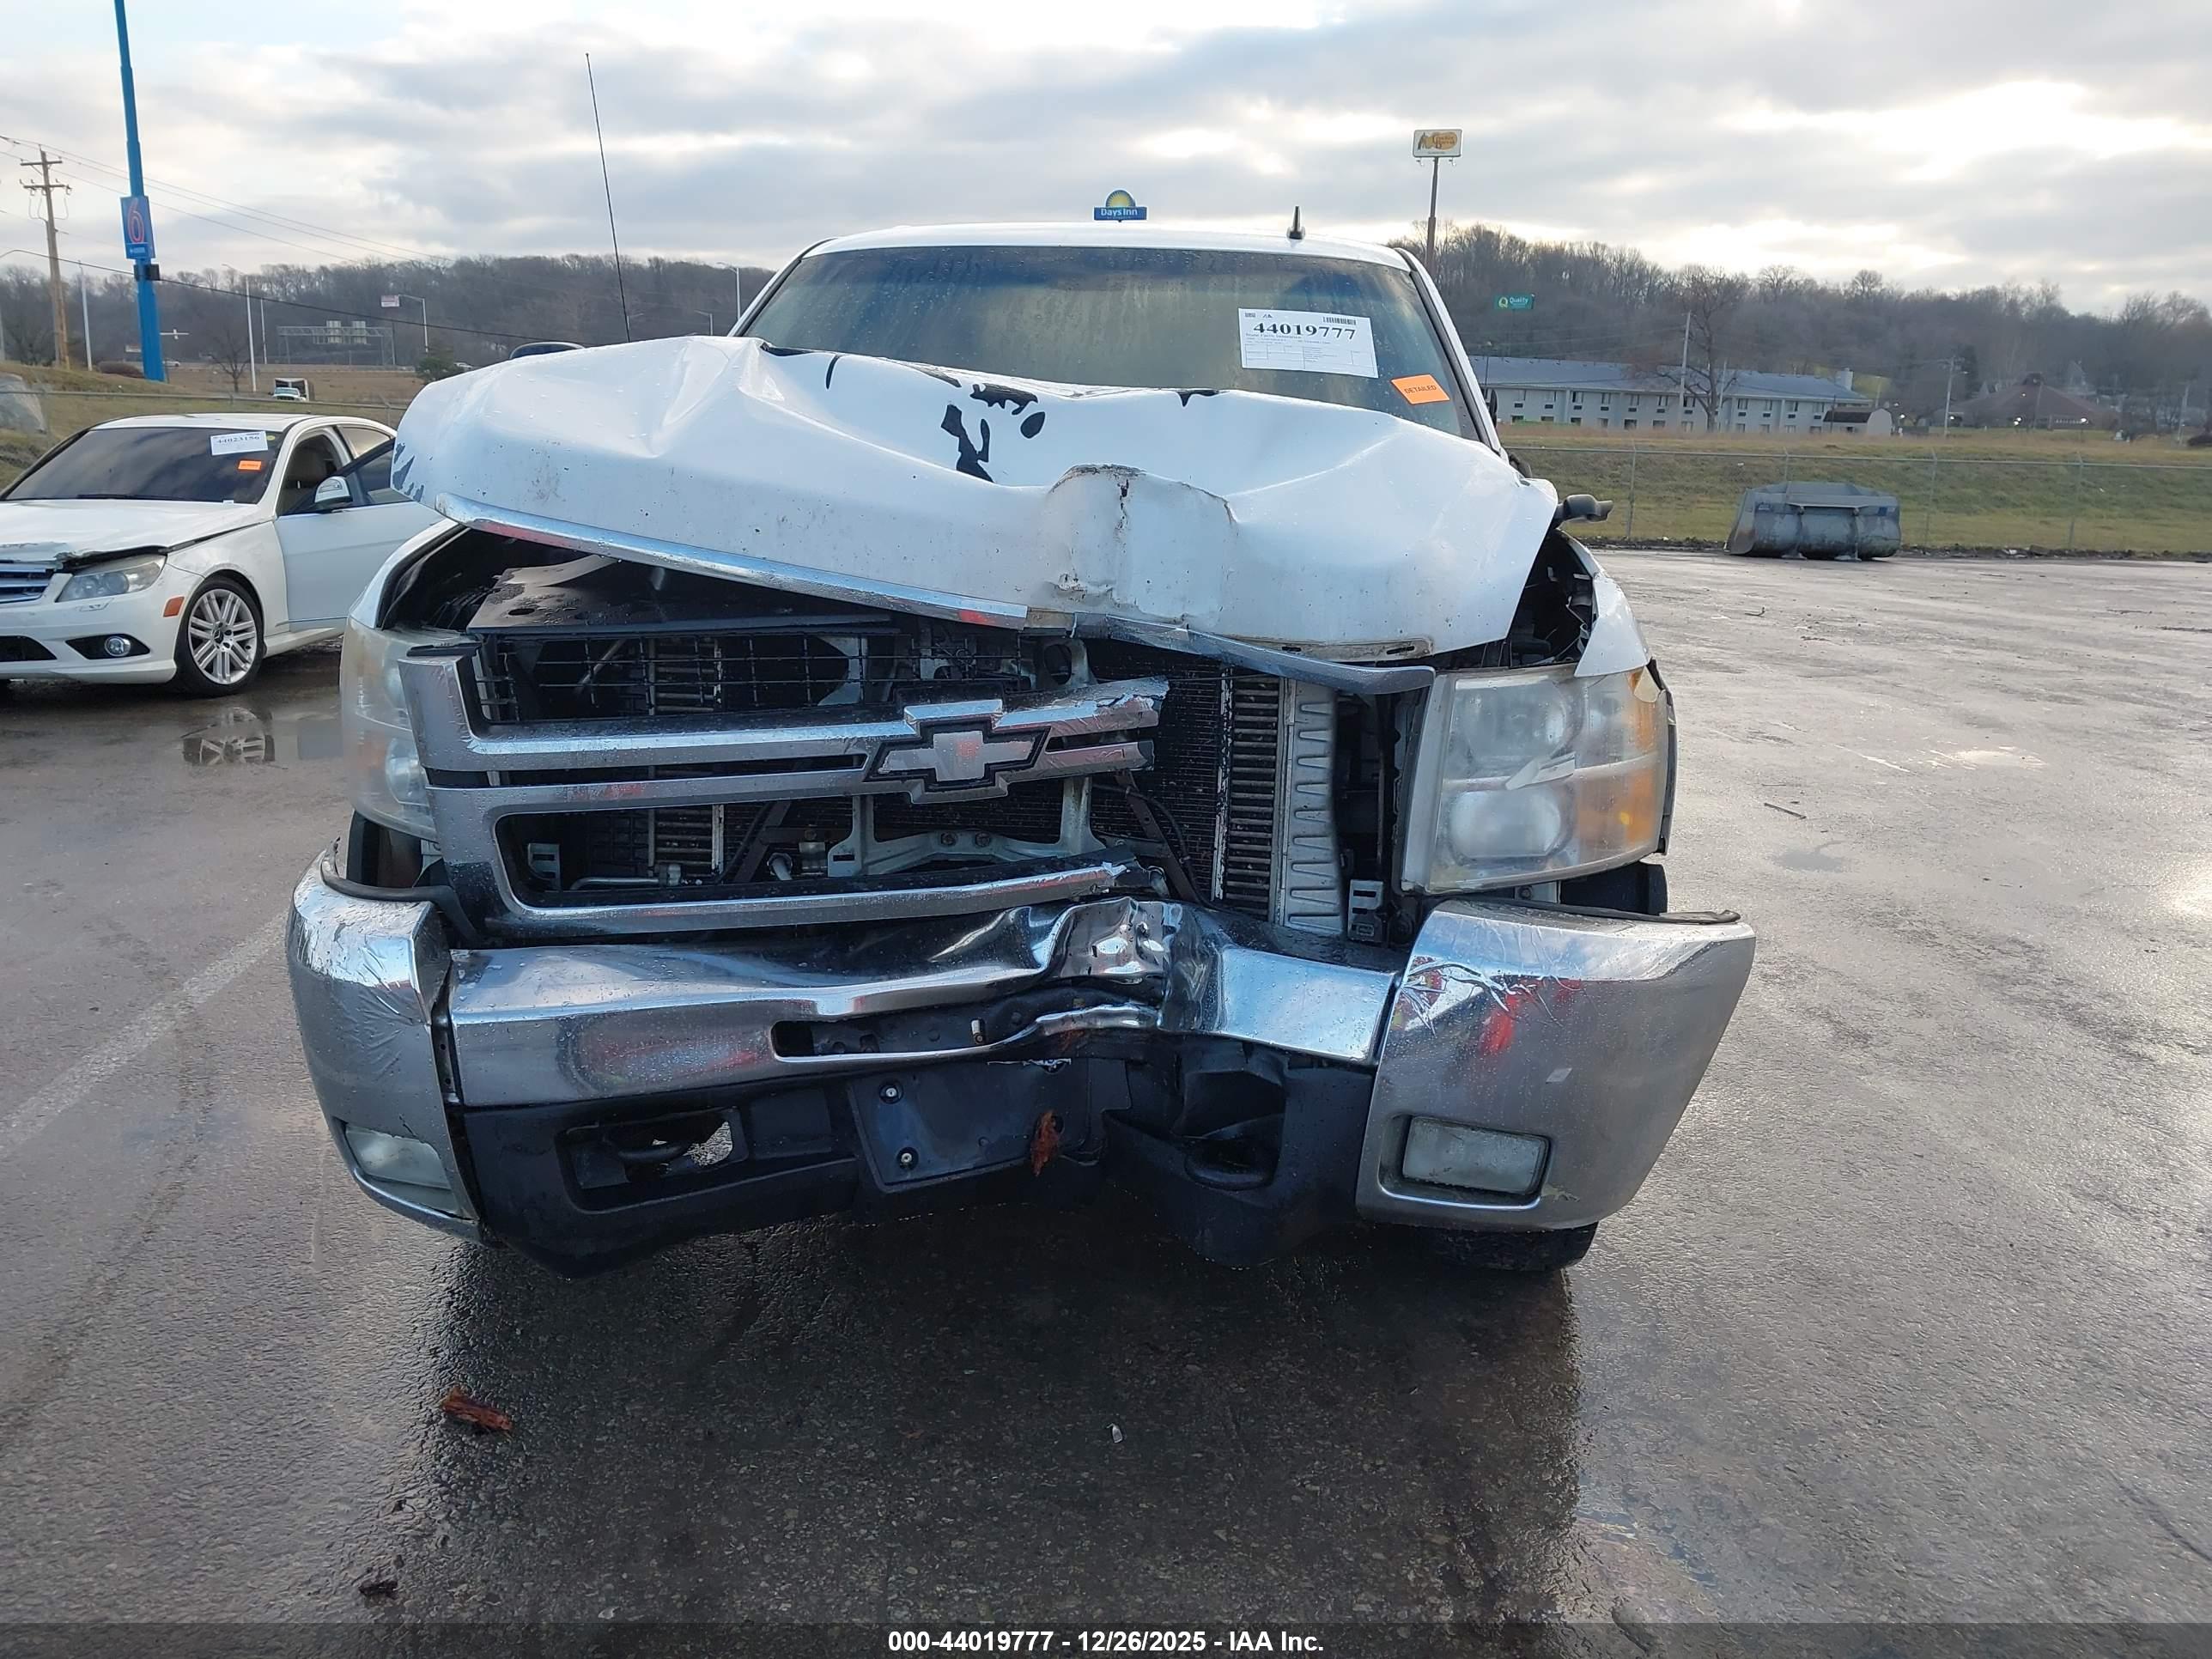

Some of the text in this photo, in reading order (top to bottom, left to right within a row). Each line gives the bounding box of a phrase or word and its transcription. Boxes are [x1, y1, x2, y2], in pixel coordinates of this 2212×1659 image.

[1100, 208, 1122, 216] Days
[127, 197, 144, 244] 6
[1253, 322, 1356, 340] 44019777
[1404, 385, 1437, 393] DETAILED
